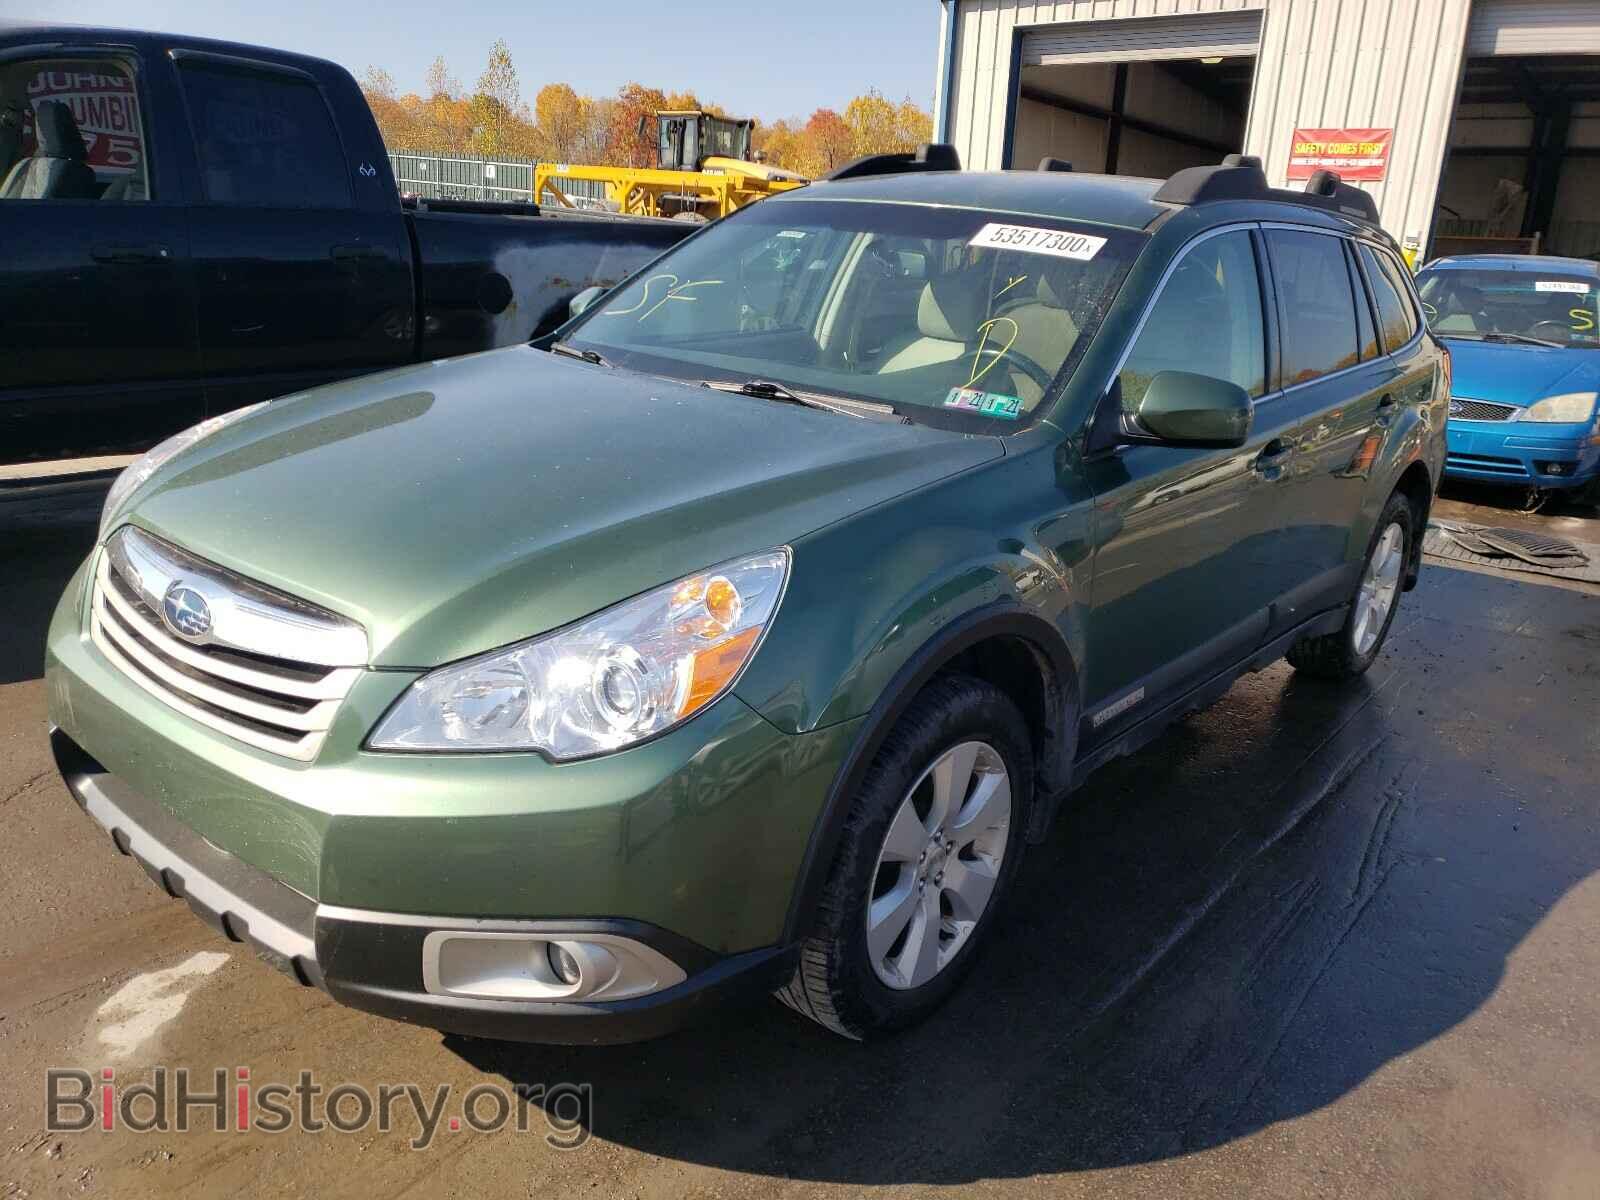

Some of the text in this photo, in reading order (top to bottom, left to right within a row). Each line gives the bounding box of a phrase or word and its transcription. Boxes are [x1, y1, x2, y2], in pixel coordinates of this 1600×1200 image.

[1295, 142, 1384, 155] SAFETY COMES FIRST
